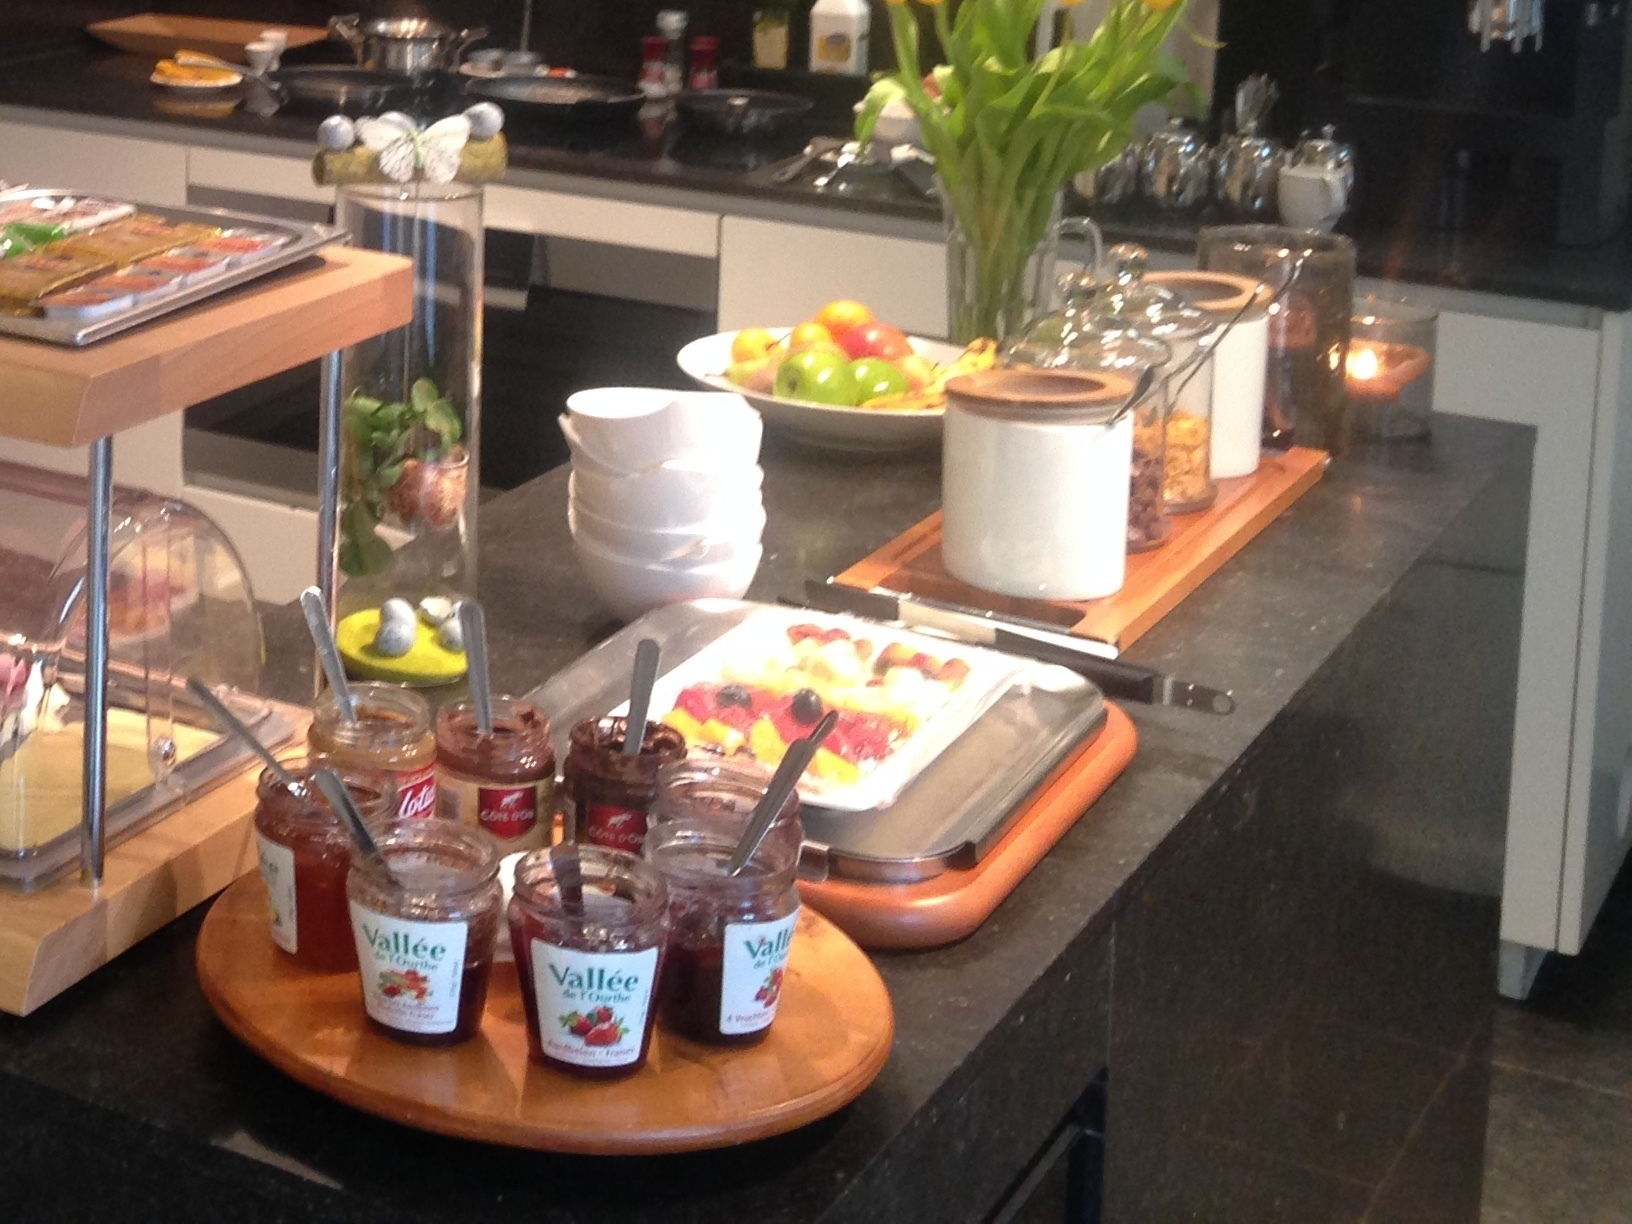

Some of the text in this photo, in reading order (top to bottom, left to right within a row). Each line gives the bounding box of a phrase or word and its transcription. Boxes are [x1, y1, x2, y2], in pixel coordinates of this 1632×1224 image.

[398, 786, 436, 818] Lotu
[362, 924, 446, 962] Vallée
[549, 963, 639, 992] Vallée
